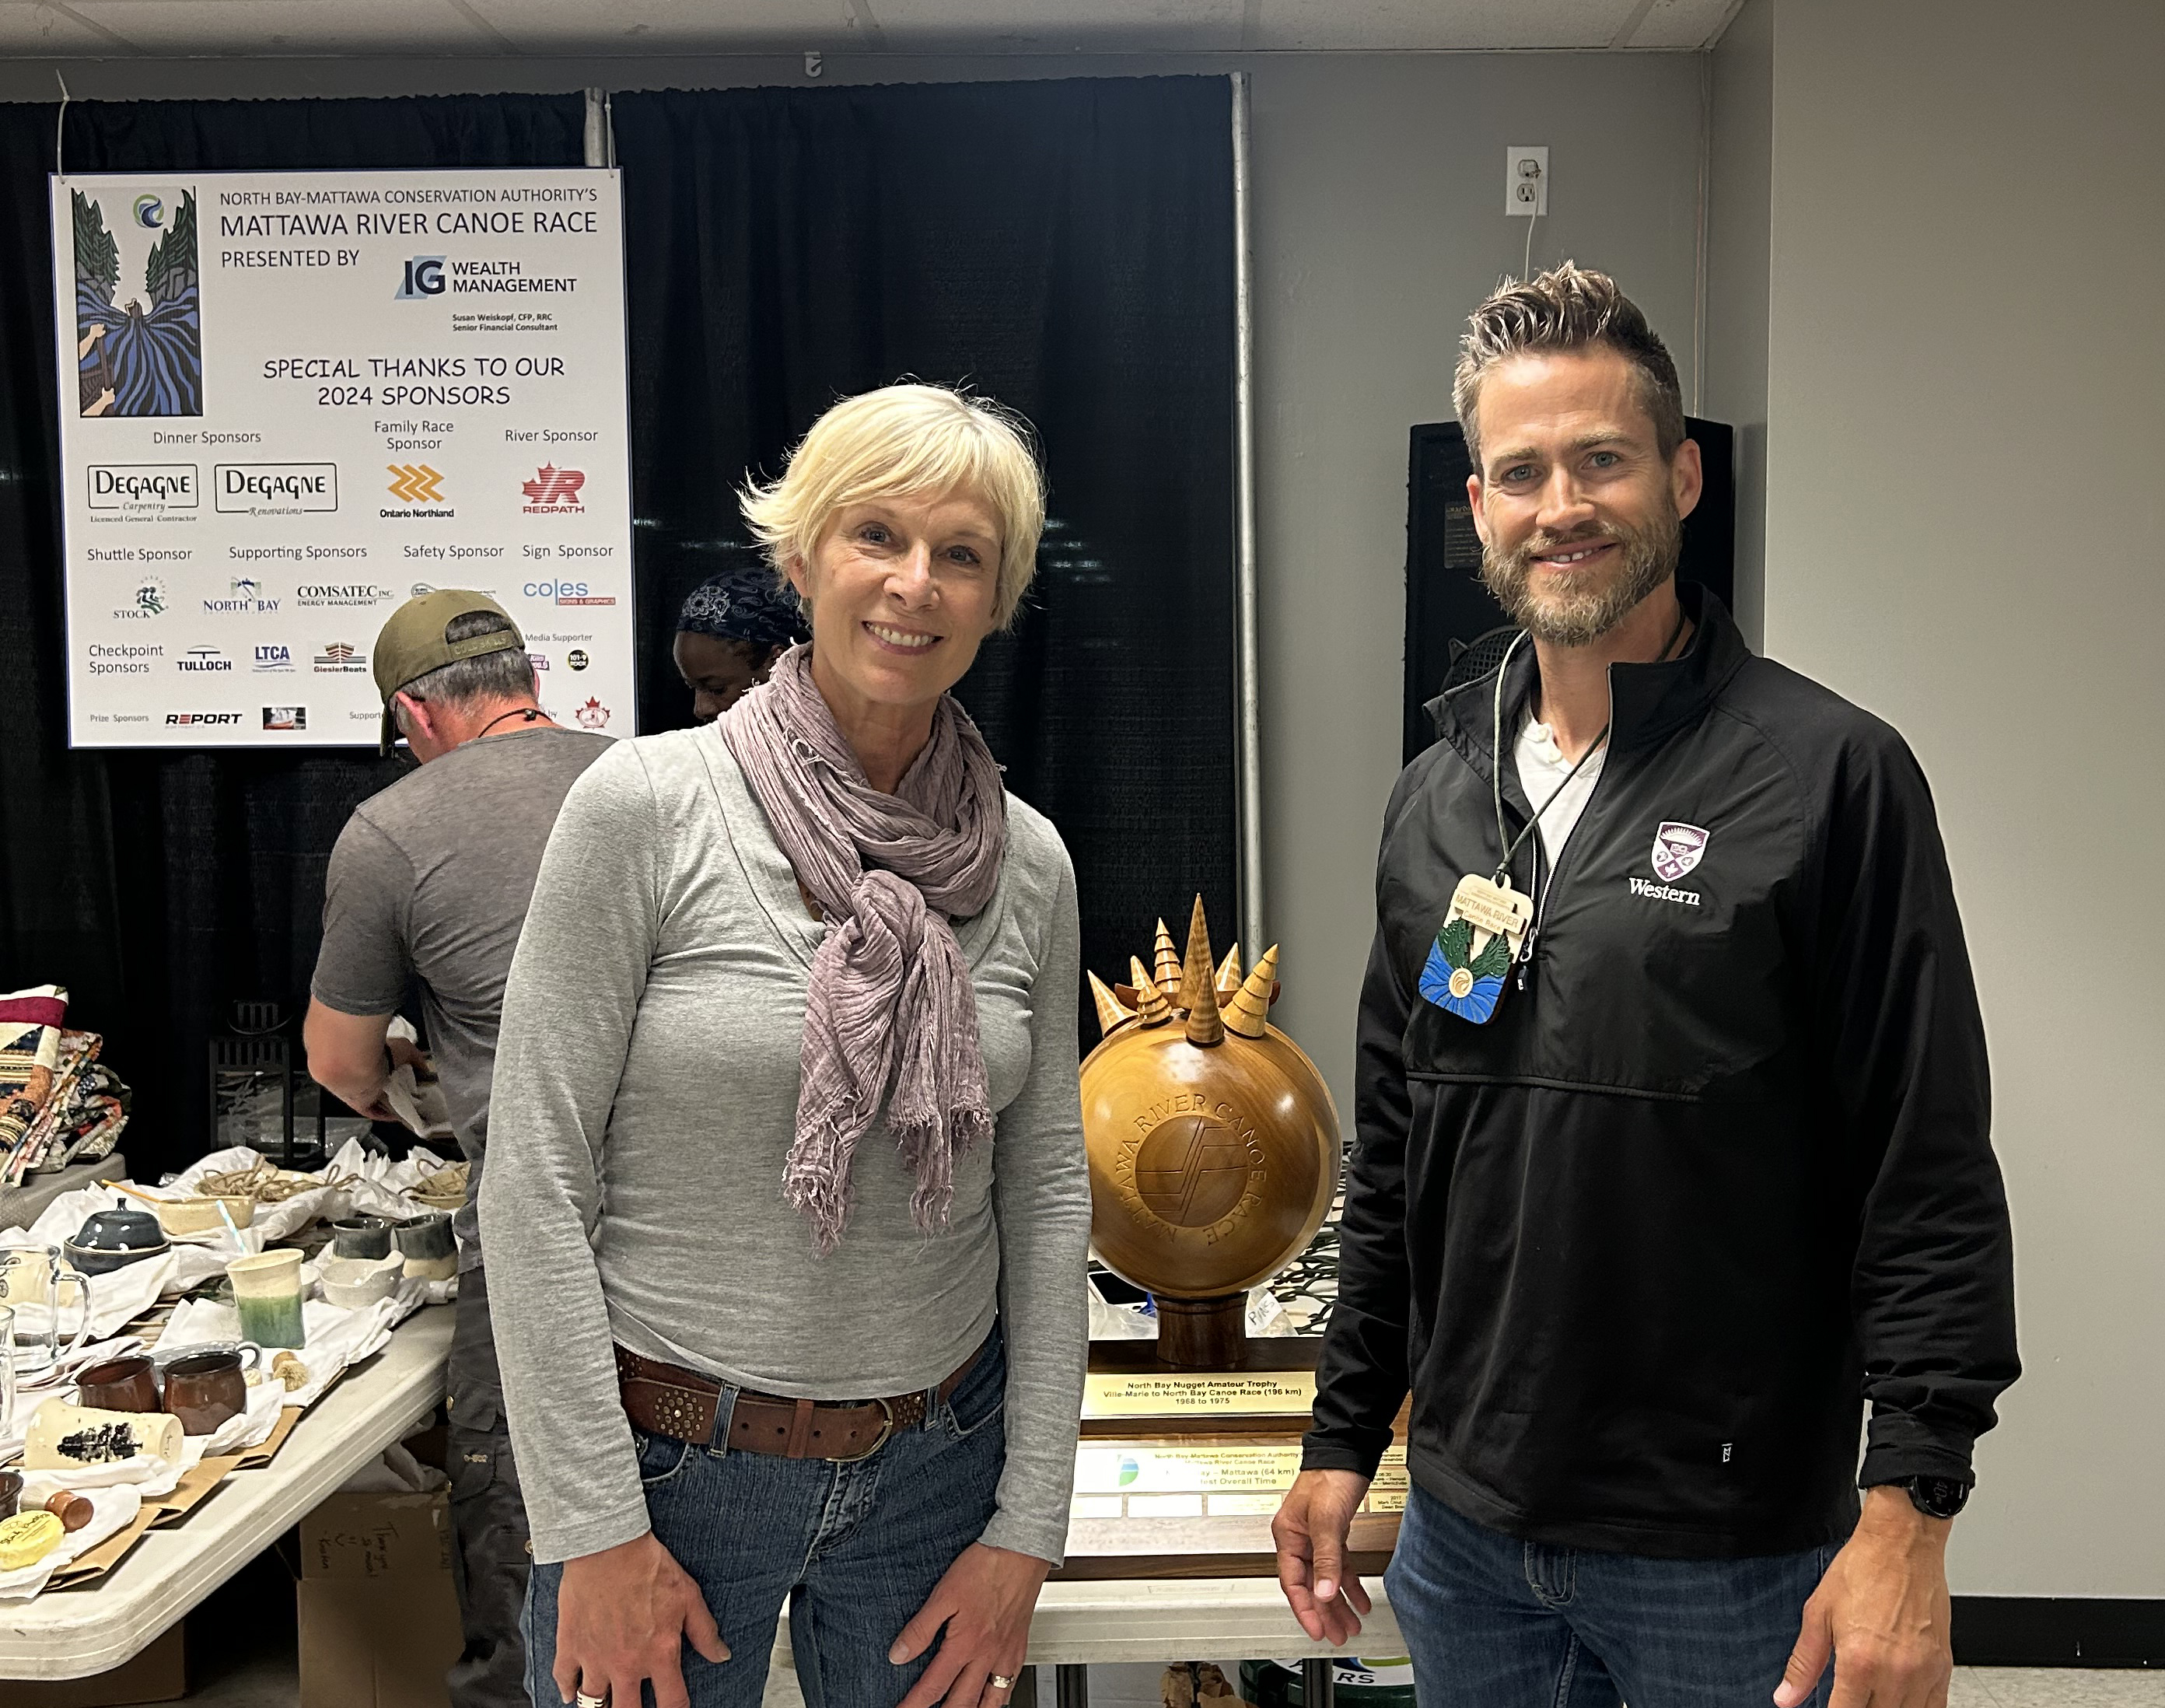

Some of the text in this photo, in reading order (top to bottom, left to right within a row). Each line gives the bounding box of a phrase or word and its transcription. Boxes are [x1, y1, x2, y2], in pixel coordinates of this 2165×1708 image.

[221, 188, 596, 205] NORTH BAY-MATTAWA CONSERVATION AUTHORITY'S
[222, 212, 596, 236] MATTAWA RIVER CANOE RACE
[222, 250, 359, 268] PRESENTED BY
[452, 262, 519, 275] WEALTH
[404, 260, 446, 296] IG
[453, 278, 577, 292] MANAGEMENT
[452, 313, 475, 321] Susan
[479, 323, 514, 331] Financial
[516, 323, 558, 331] Consultant
[264, 358, 564, 378] SPECIAL THANKS TO OUR
[319, 386, 509, 405] 2024 SPONSORS
[375, 420, 453, 435] Family Race
[154, 432, 261, 446] Dinner Sponsors
[506, 429, 598, 443] River Sponsor
[387, 438, 442, 452] Sponsor
[96, 471, 190, 500] DEGAGNE
[226, 471, 325, 499] DEGAGNE
[123, 501, 166, 513] Carpentry
[249, 506, 303, 516] Renovations
[413, 509, 453, 517] Northland
[125, 515, 154, 523] General
[156, 515, 198, 523] Contractor
[88, 548, 192, 562] Shuttle Sponsor
[229, 546, 367, 561] Supporting Sponsors
[404, 545, 504, 560] Safety Sponsor
[523, 544, 614, 559] Sign Sponsor
[297, 585, 378, 598] COMSATEC
[523, 579, 589, 605] coles
[203, 599, 281, 611] NORTH BAY
[113, 610, 151, 619] STOCK
[525, 633, 593, 643] Media Supporter
[89, 644, 163, 659] Checkpoint
[255, 646, 289, 660] LTCA
[89, 662, 149, 676] Sponsors
[177, 661, 231, 670] TULLOCH
[90, 714, 149, 723] Prize Sponsors
[165, 713, 243, 724] REPORT
[1628, 877, 1701, 906] Western
[1455, 893, 1492, 917] MATTAWA
[1492, 909, 1519, 929] RIVER
[1133, 1093, 1207, 1136] RIVER
[1214, 1101, 1268, 1184] CANOE
[1202, 1192, 1263, 1246] RACE
[1127, 1380, 1278, 1391] North Bay Nugget Amateur Trophy
[1103, 1390, 1149, 1398] Ville-Marie
[1152, 1389, 1160, 1398] to
[1163, 1389, 1187, 1398] North
[1190, 1389, 1208, 1398] Bay
[1208, 1388, 1237, 1397] Canoe
[1240, 1388, 1261, 1397] Race
[1285, 1388, 1302, 1397] km)
[1220, 1468, 1259, 1477] Mattawa
[1261, 1468, 1275, 1477] (64
[1278, 1468, 1296, 1477] km)
[1219, 1477, 1253, 1486] Overall
[1254, 1476, 1277, 1486] Time
